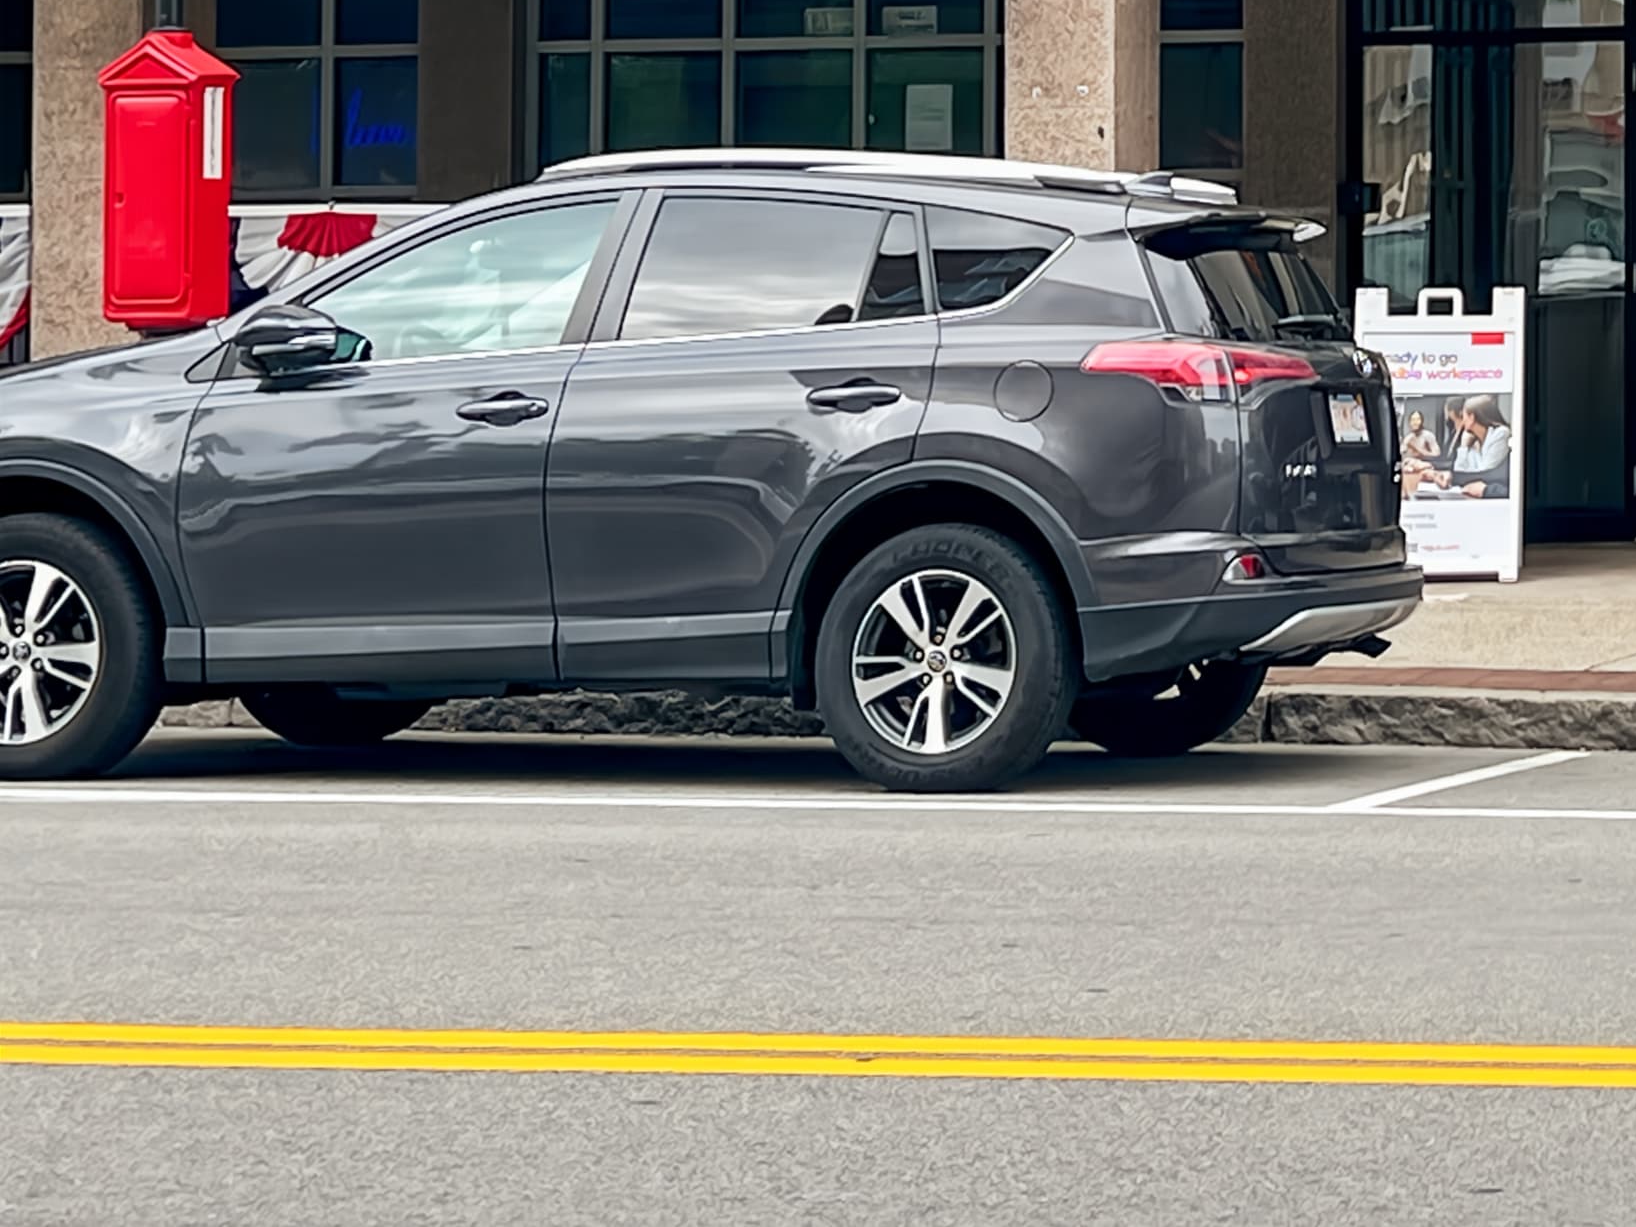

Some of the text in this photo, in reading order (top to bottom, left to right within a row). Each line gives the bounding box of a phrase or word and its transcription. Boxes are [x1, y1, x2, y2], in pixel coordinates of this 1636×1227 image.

[1421, 351, 1436, 365] to
[1439, 353, 1458, 367] go
[1426, 367, 1504, 383] workspace
